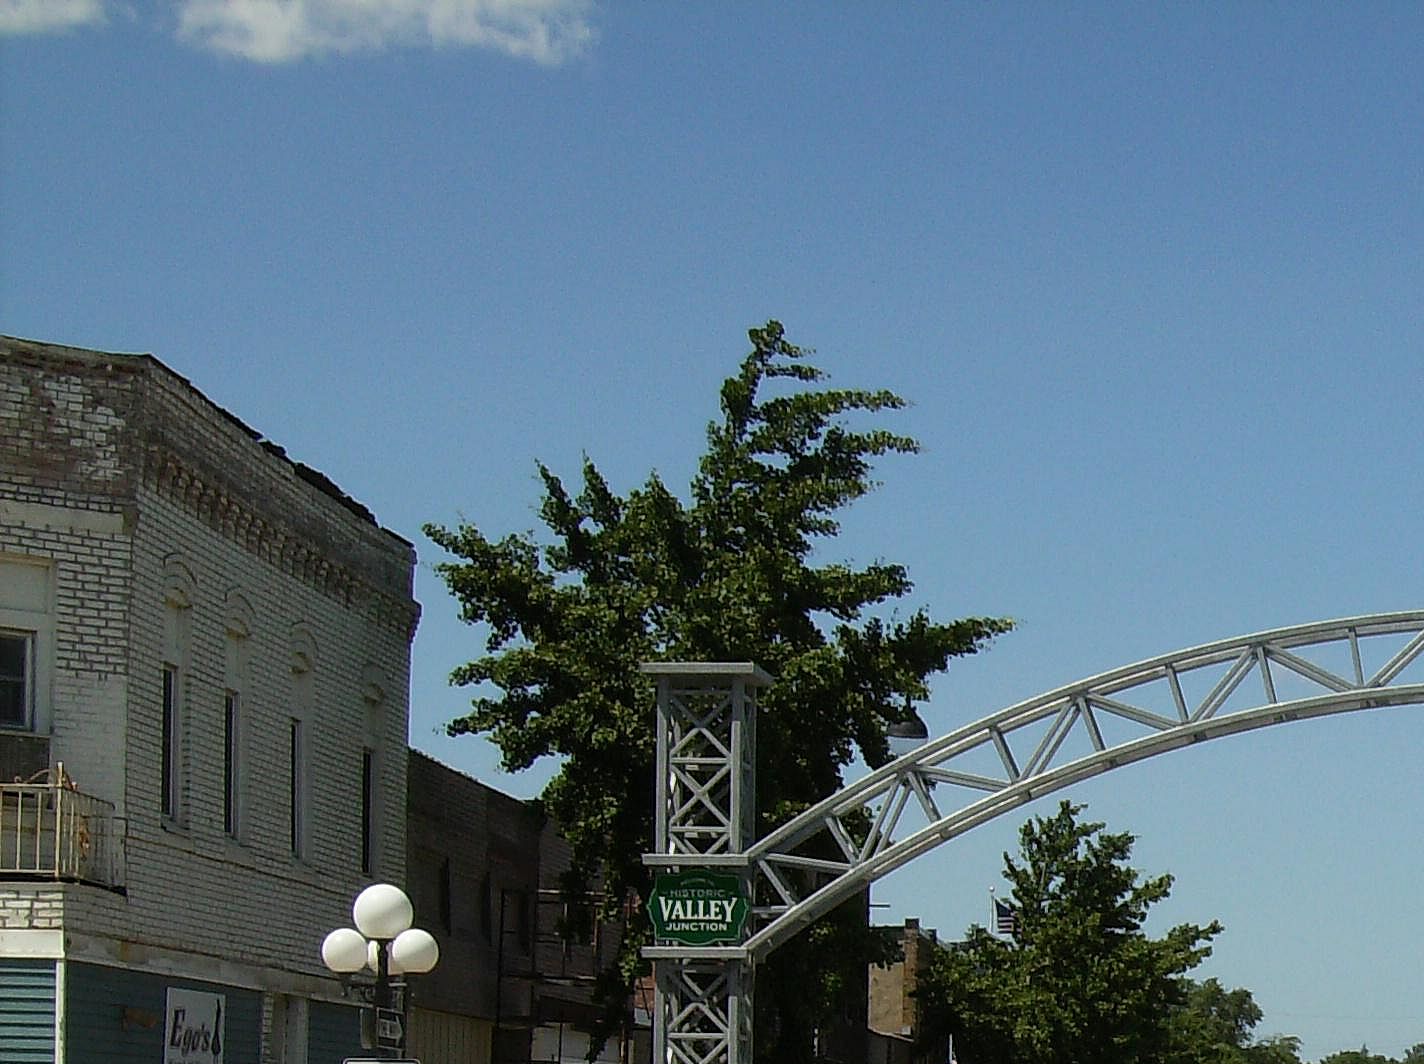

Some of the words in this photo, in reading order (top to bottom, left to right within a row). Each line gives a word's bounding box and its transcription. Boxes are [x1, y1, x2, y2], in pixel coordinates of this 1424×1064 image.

[670, 889, 726, 898] HISTORIC
[658, 896, 738, 923] VALLEY
[665, 922, 728, 932] JUNCTION
